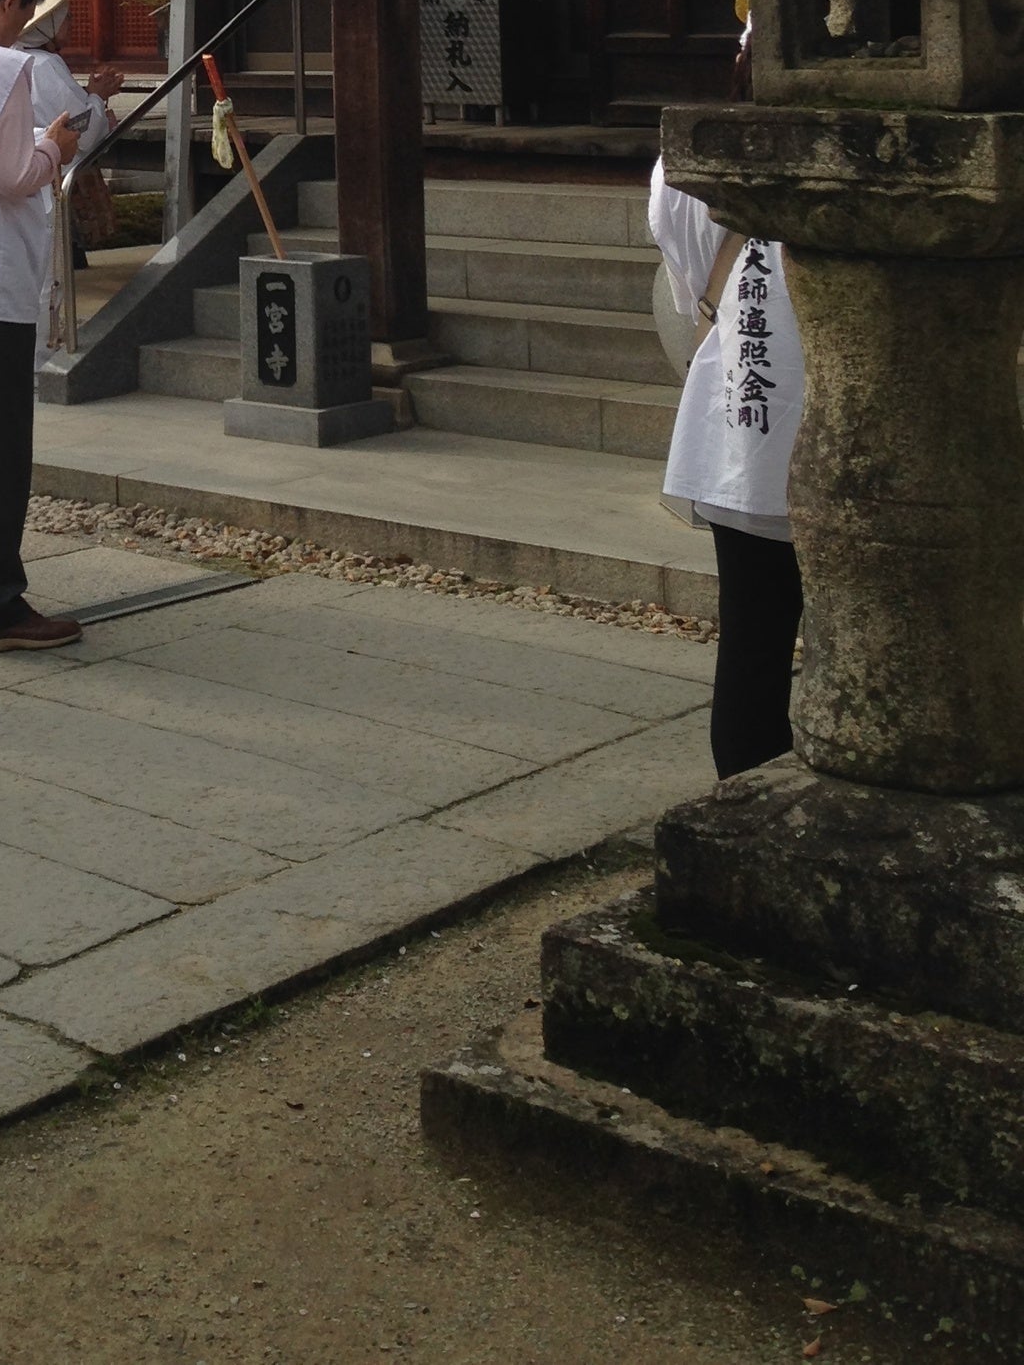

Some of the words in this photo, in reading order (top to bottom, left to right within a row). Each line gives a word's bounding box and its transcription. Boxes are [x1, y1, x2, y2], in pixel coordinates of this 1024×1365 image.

[443, 11, 473, 93] 納札入
[264, 281, 289, 381] 一宮寺
[737, 240, 777, 435] 大師遍照金剛
